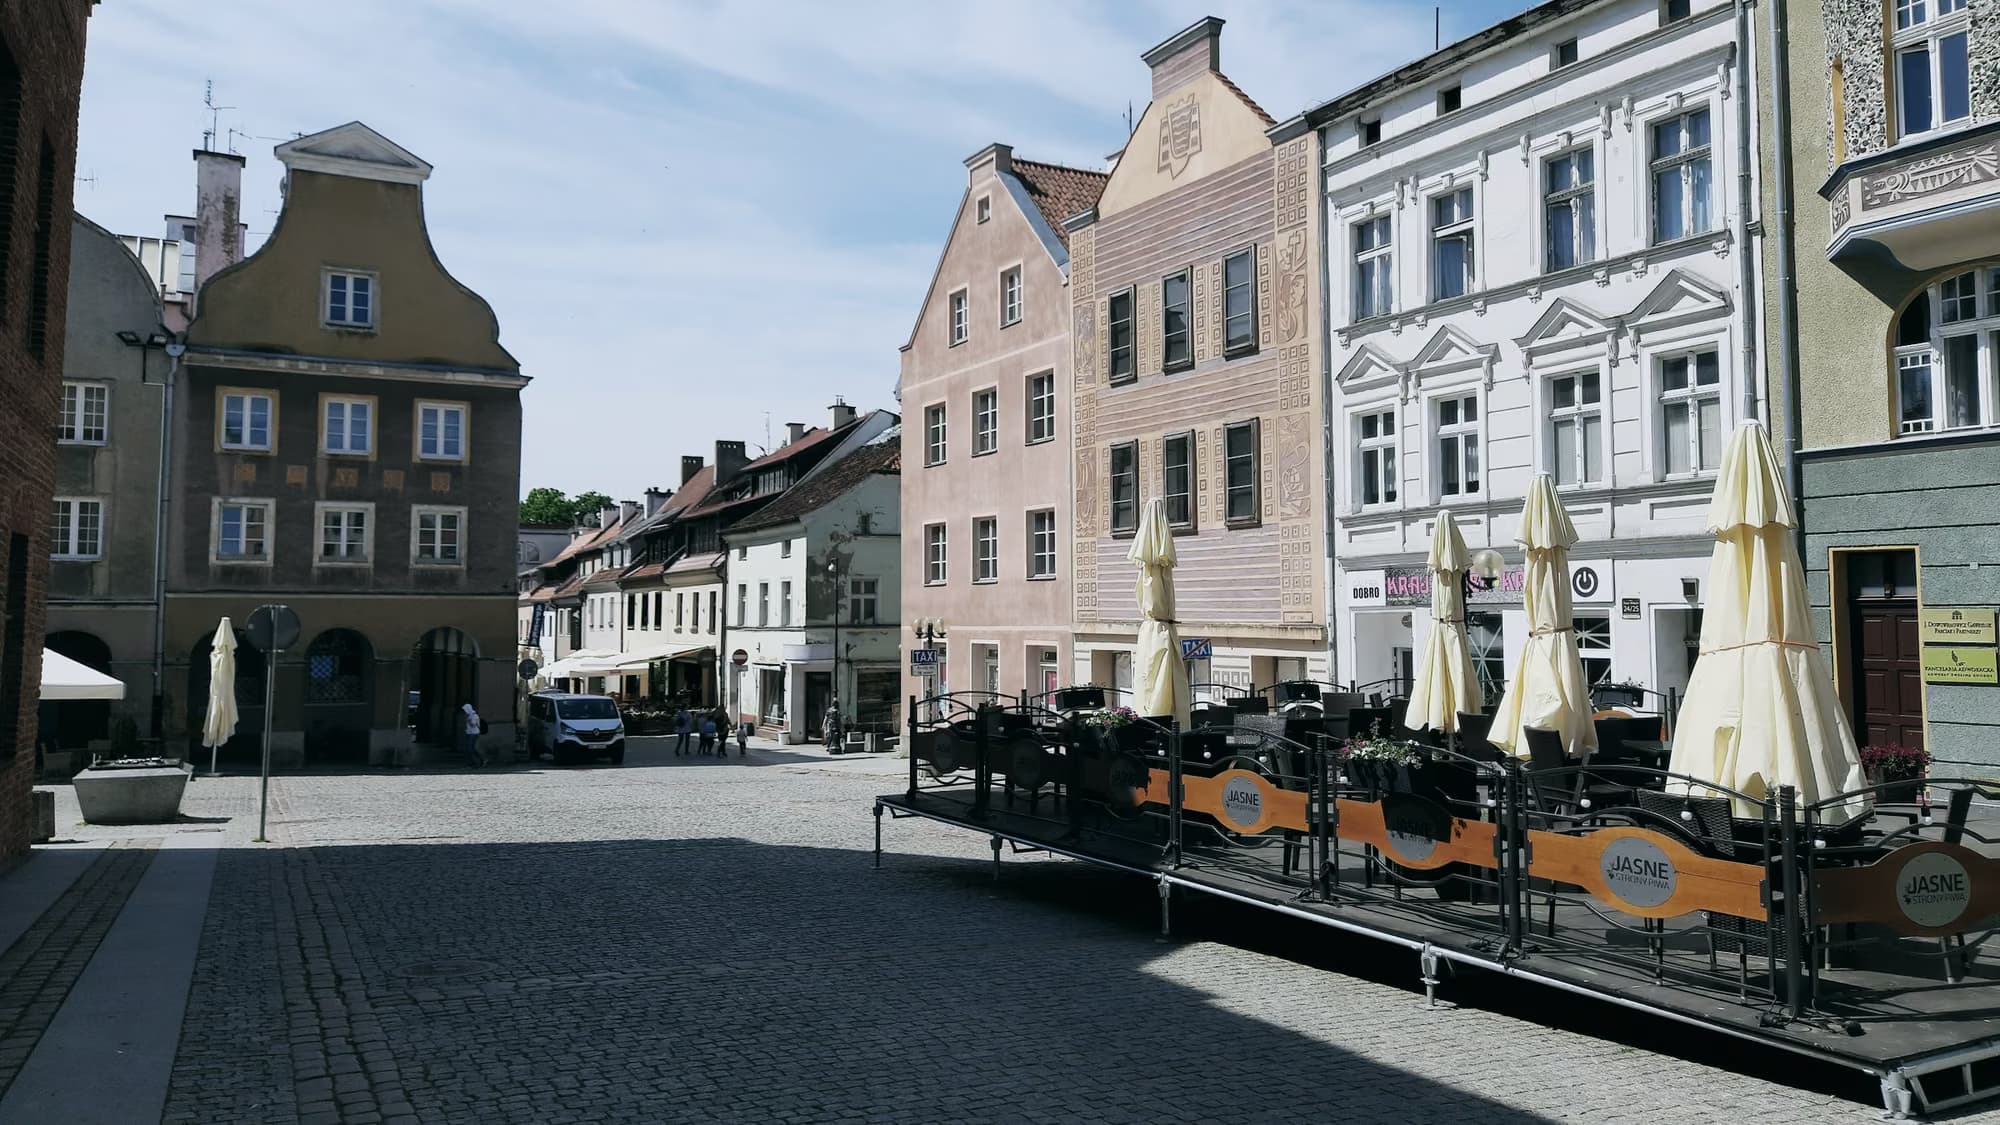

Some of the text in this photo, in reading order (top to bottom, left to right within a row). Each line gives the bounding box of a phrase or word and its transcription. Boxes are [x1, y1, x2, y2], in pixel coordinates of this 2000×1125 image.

[1353, 587, 1379, 599] DOBRO
[1183, 640, 1211, 656] TAXI
[914, 651, 937, 662] TAXI
[1228, 789, 1260, 807] JASNE
[1612, 855, 1669, 880] JASNE
[1616, 873, 1647, 885] STRONY
[1907, 873, 1964, 894] JASNE
